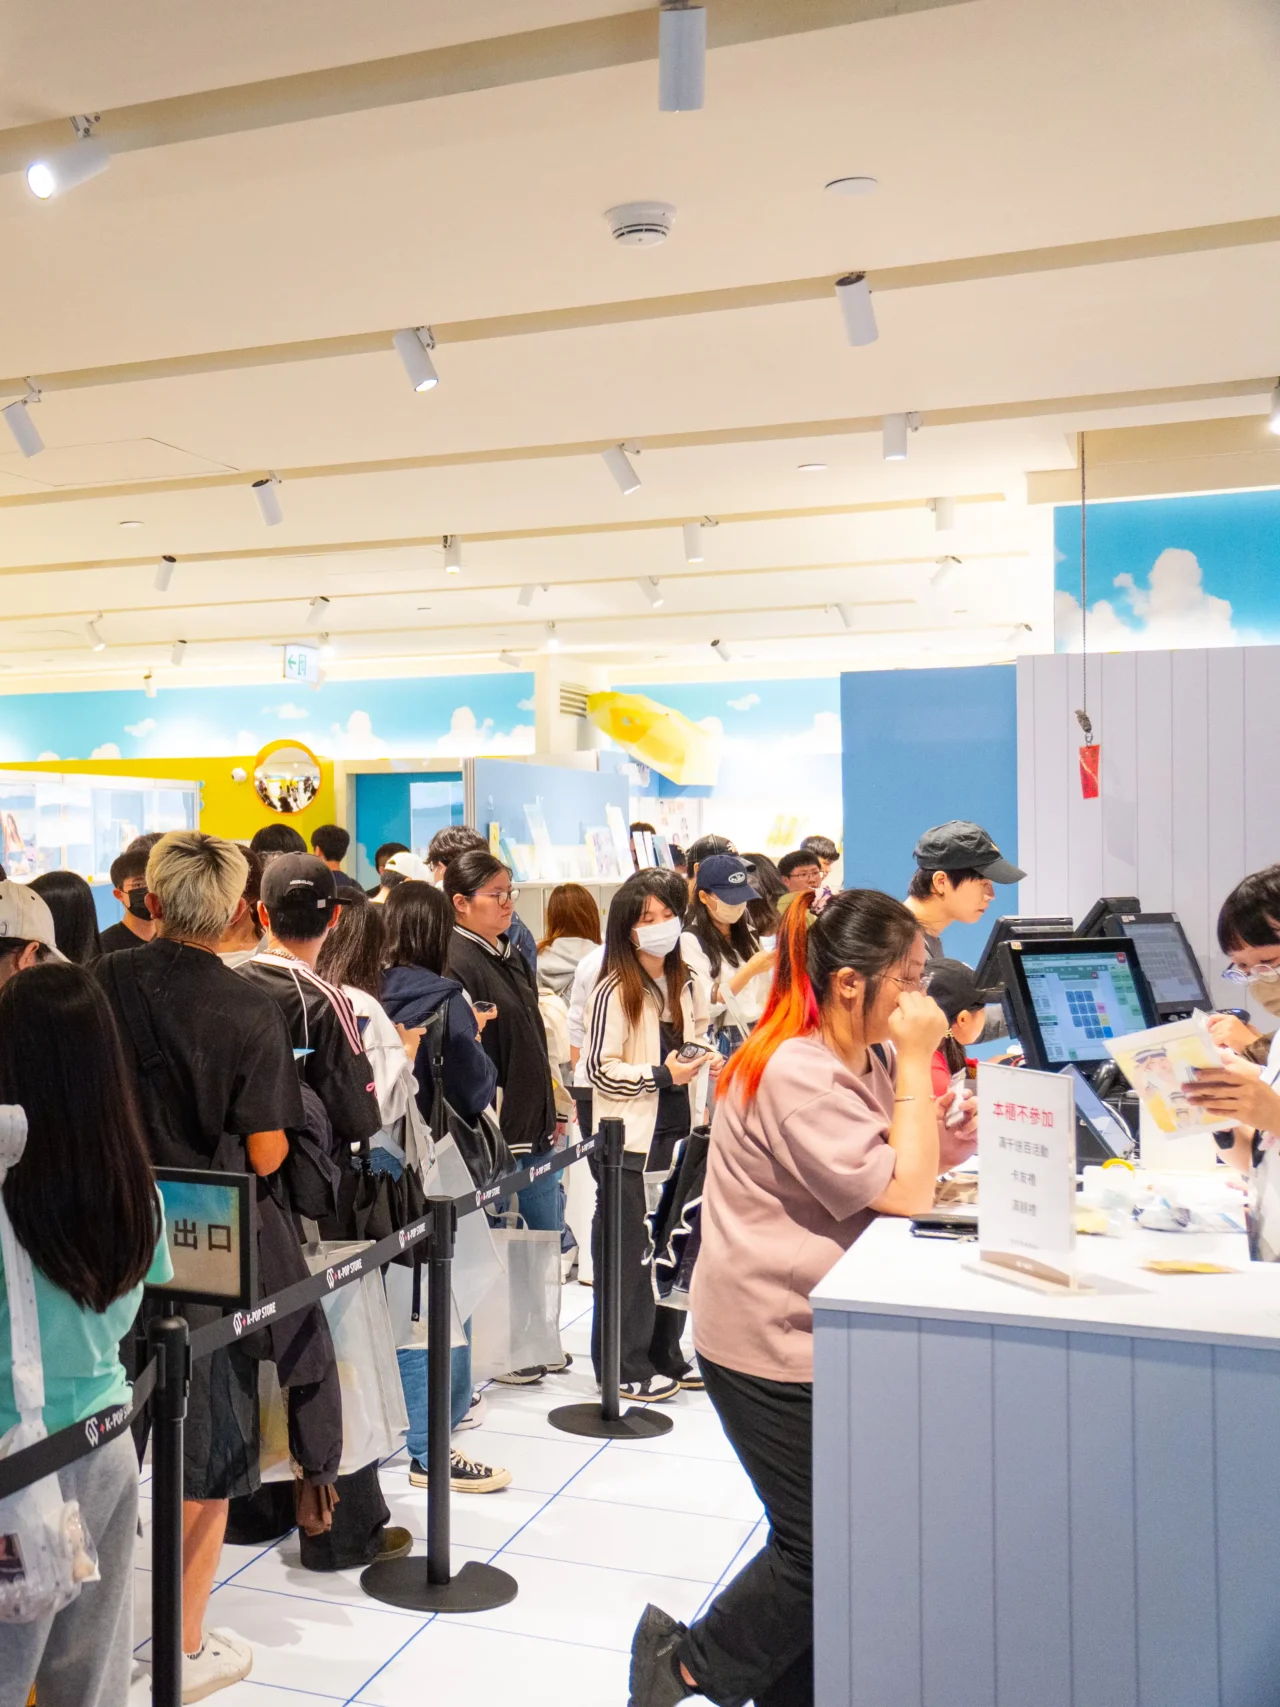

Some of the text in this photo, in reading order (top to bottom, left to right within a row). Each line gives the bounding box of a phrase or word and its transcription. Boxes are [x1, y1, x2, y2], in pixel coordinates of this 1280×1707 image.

[992, 1100, 1054, 1128] 本櫃不參加
[174, 1218, 231, 1253] 出口
[246, 1301, 276, 1326] K-POP STORE
